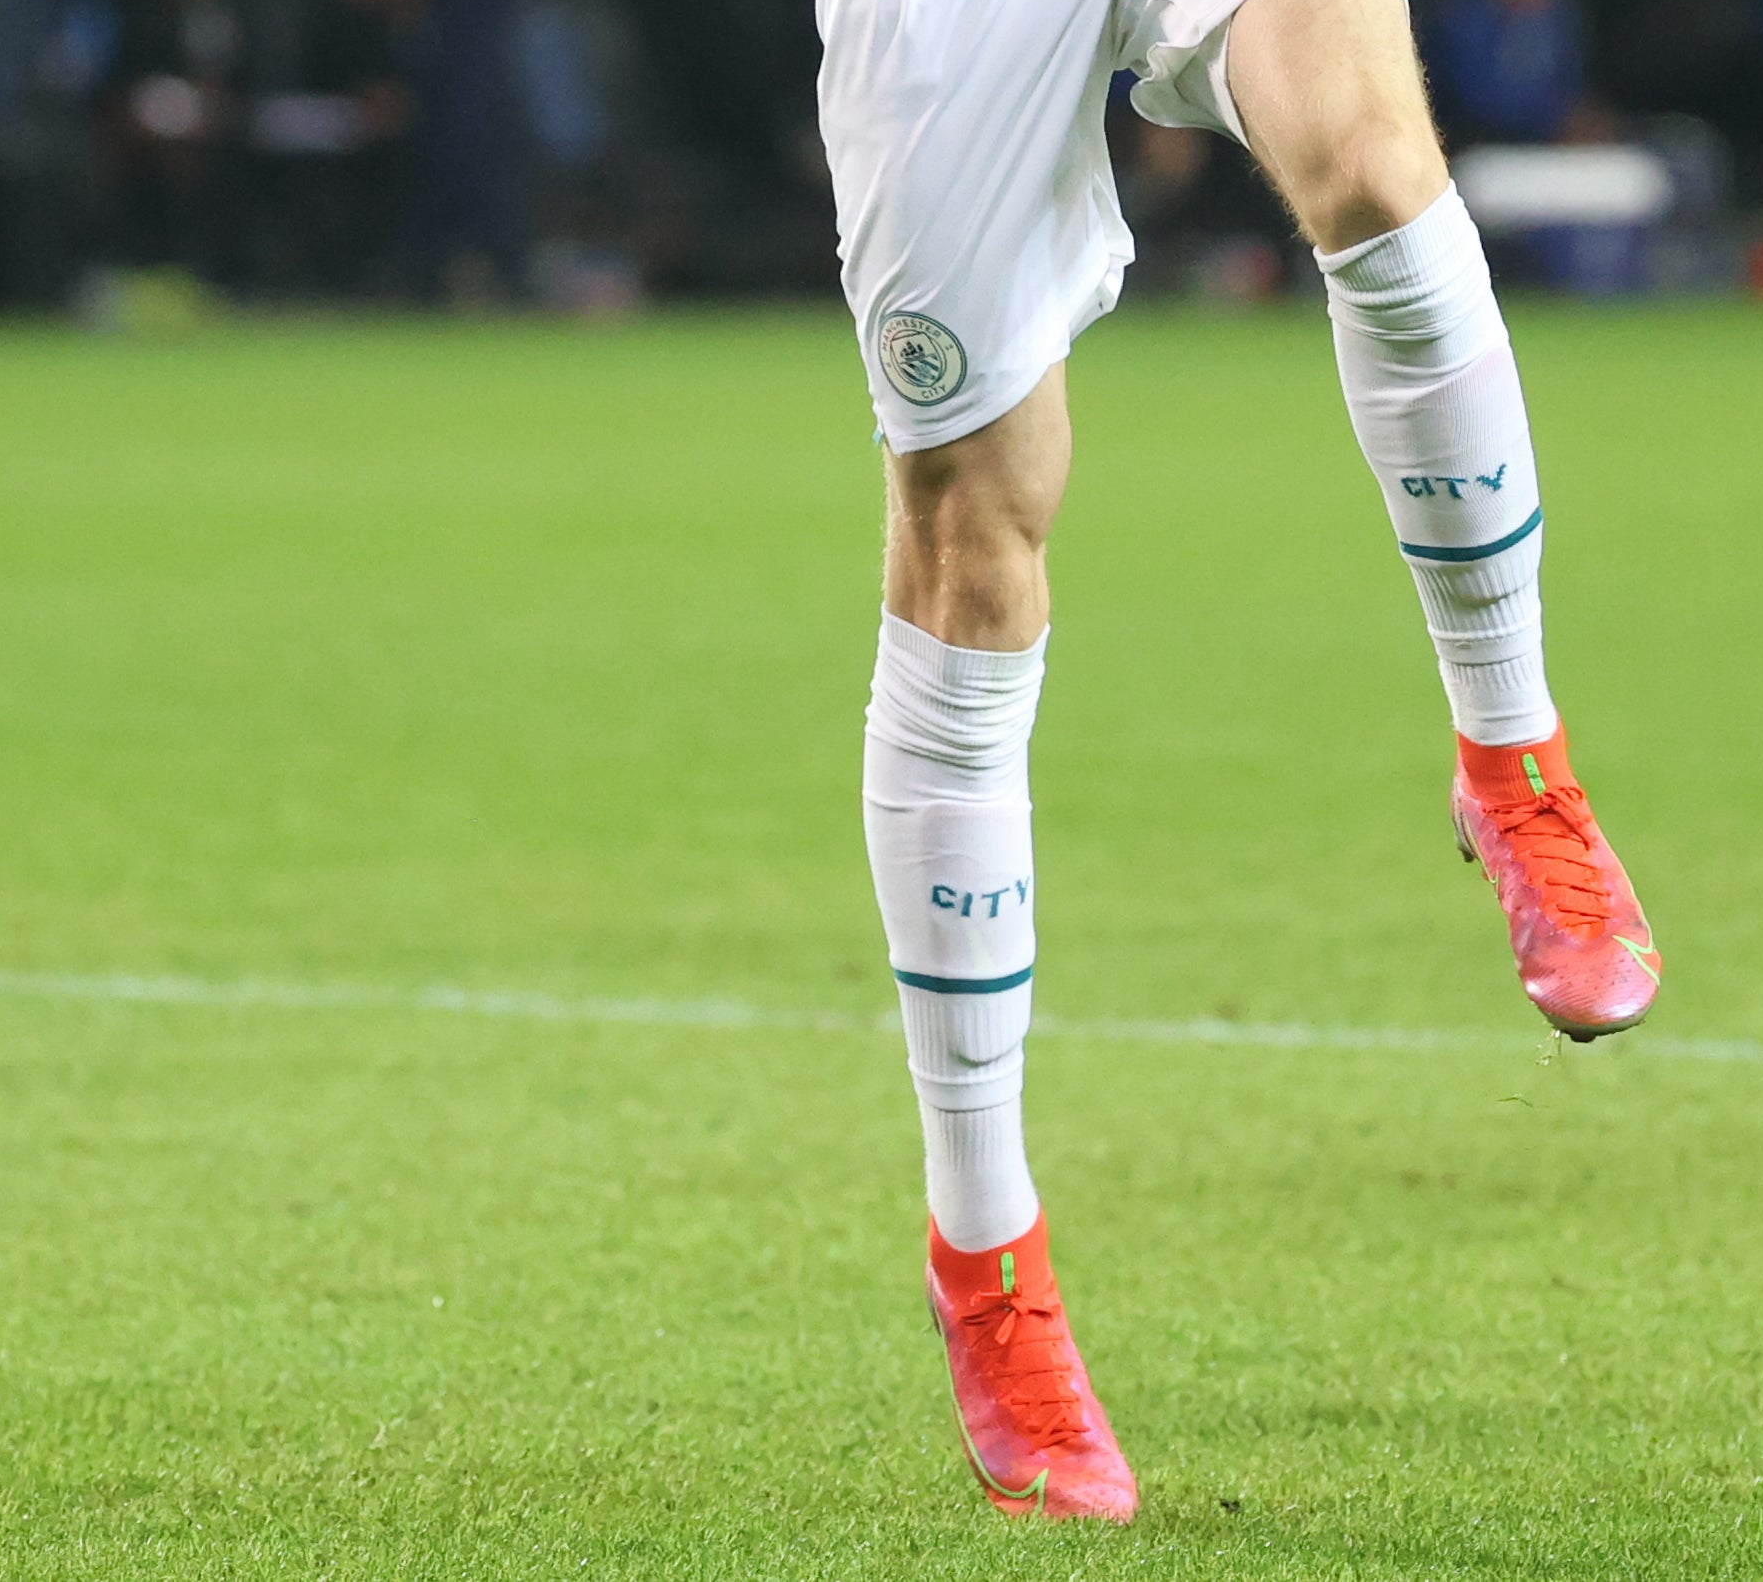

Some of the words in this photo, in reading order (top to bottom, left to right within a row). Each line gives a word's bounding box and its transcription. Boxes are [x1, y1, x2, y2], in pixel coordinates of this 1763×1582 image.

[882, 318, 942, 351] MANCHESTER
[921, 384, 947, 399] CITY
[1401, 463, 1506, 499] CITY
[930, 876, 1030, 918] CITY
